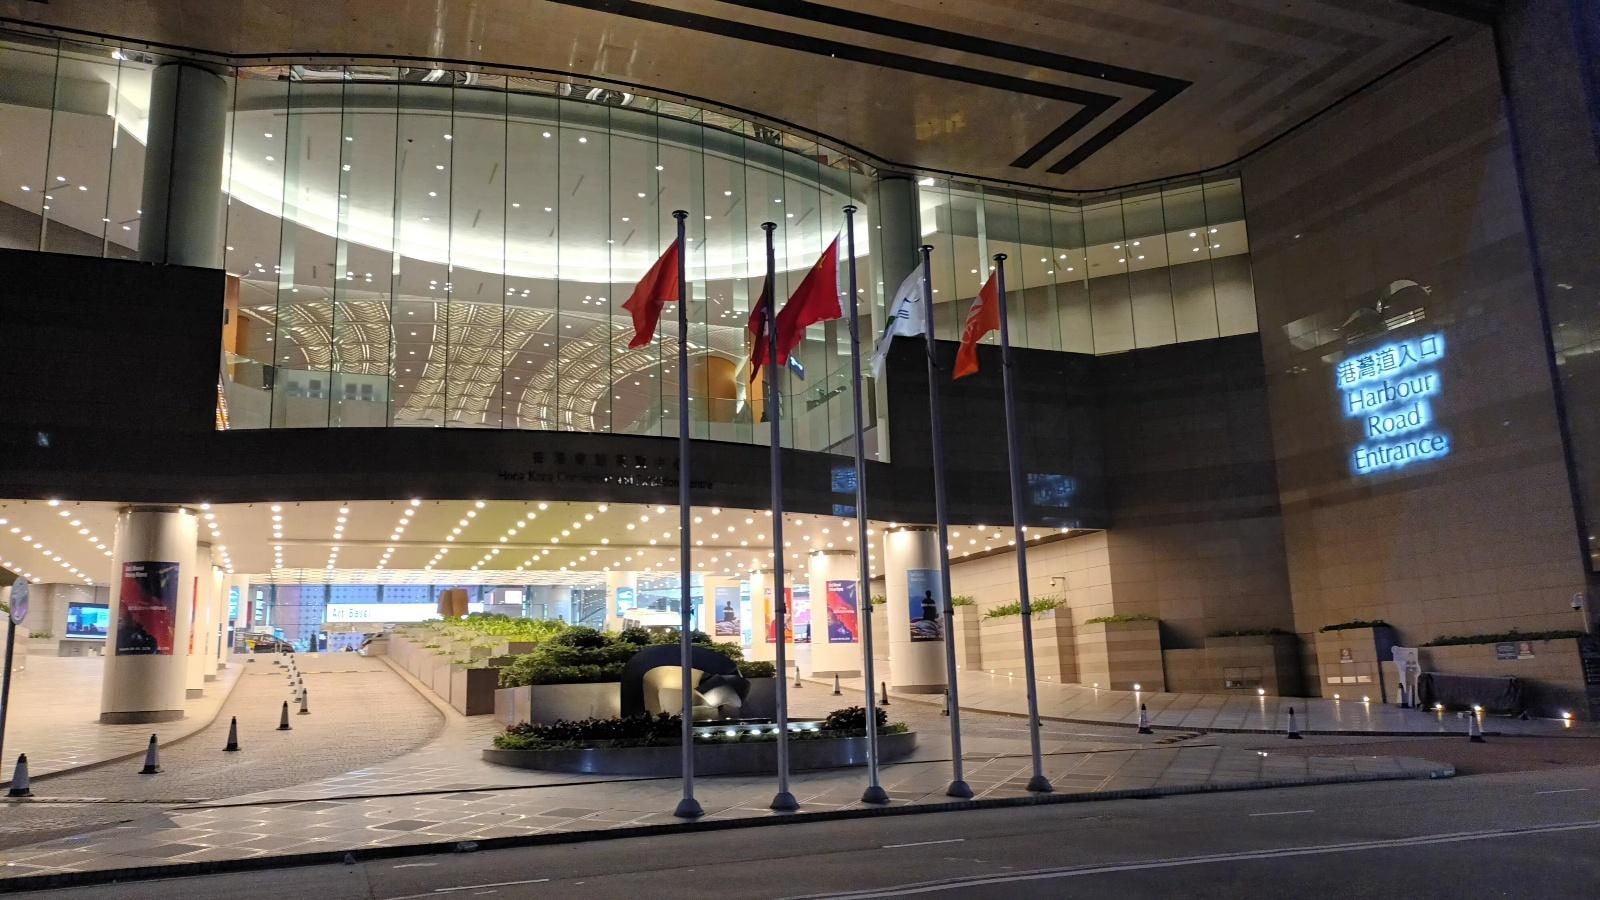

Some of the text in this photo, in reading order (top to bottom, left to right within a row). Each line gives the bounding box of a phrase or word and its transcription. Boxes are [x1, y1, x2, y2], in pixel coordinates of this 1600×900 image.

[1337, 336, 1438, 386] 港灣道入口
[1348, 374, 1433, 412] Harbour
[1367, 402, 1421, 437] Road
[1353, 434, 1445, 470] Entrance
